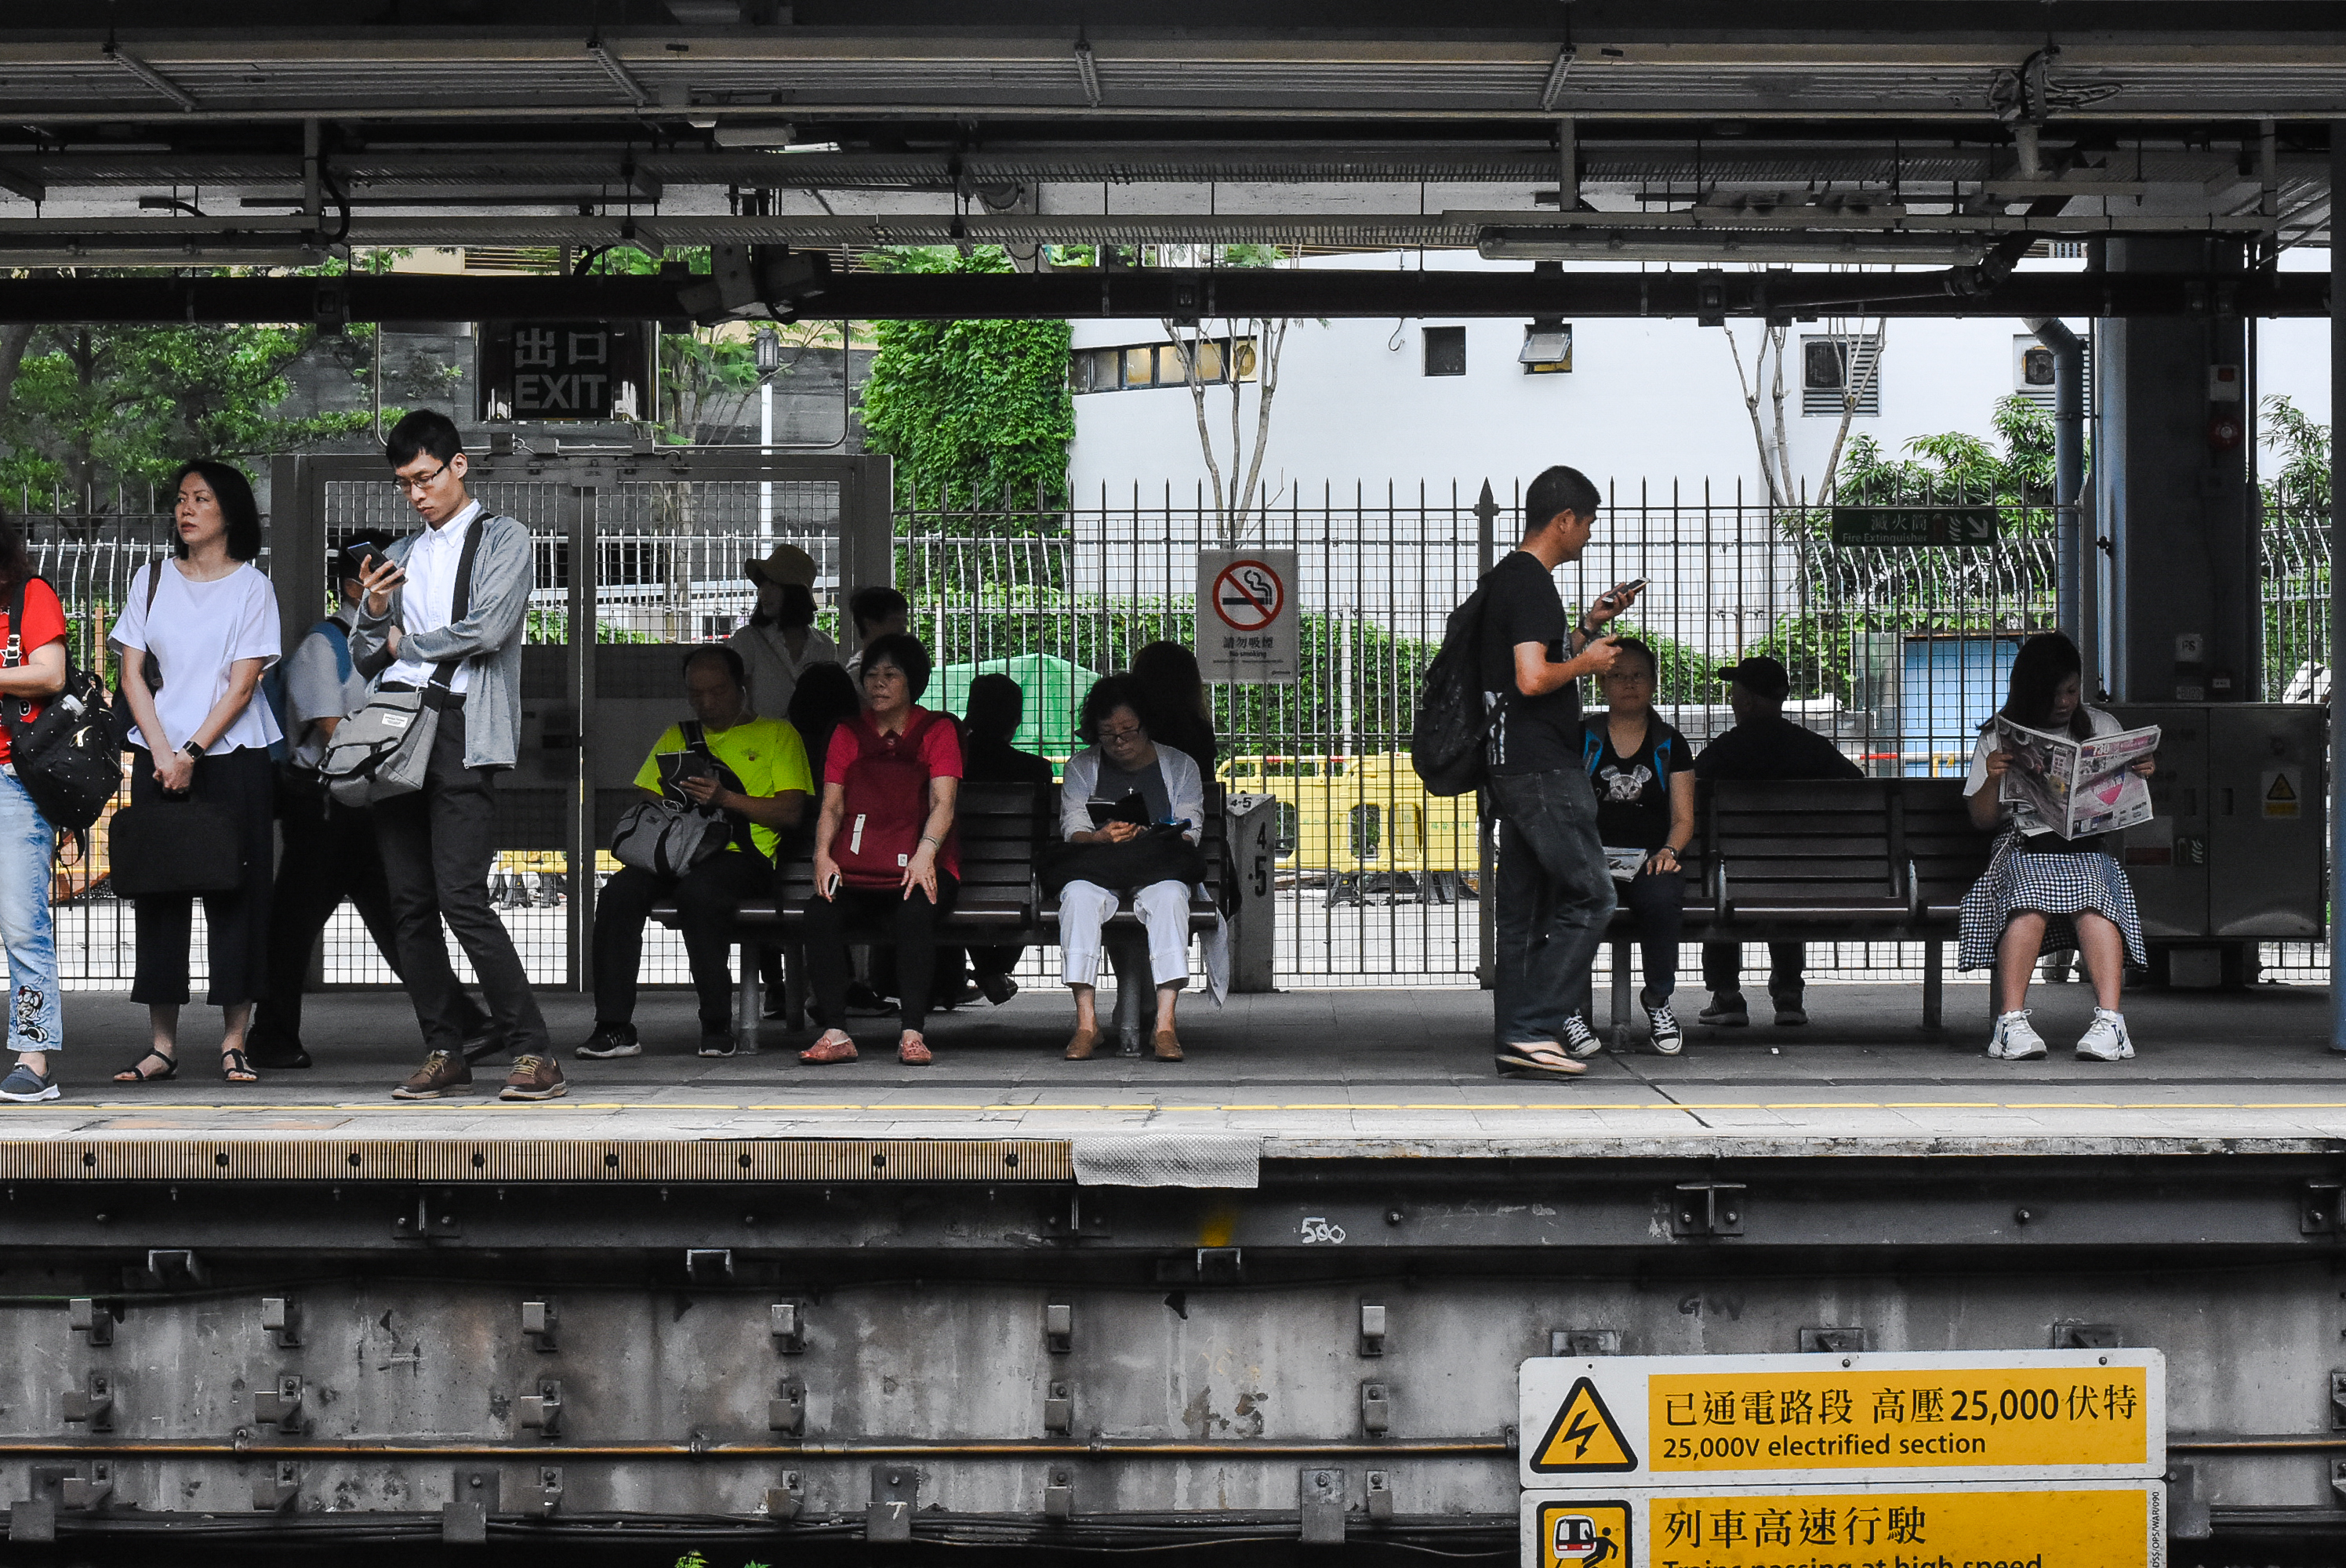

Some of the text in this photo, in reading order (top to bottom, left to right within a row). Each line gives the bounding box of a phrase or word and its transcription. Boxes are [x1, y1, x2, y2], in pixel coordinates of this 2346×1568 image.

[514, 328, 608, 368] 出口
[514, 374, 608, 409] EXIT
[1871, 514, 1928, 531] 滅火筒
[1842, 532, 1928, 545] Fire Extinguisher
[1222, 636, 1274, 649] 請勿吸煙
[1240, 650, 1267, 659] smoking
[1230, 797, 1253, 808] 4-5
[1664, 1384, 2138, 1427] 已通電路段 高壓25,000伏特
[1663, 1432, 1986, 1461] 25,000V electrified section
[1664, 1505, 1927, 1549] 列車高速行駛
